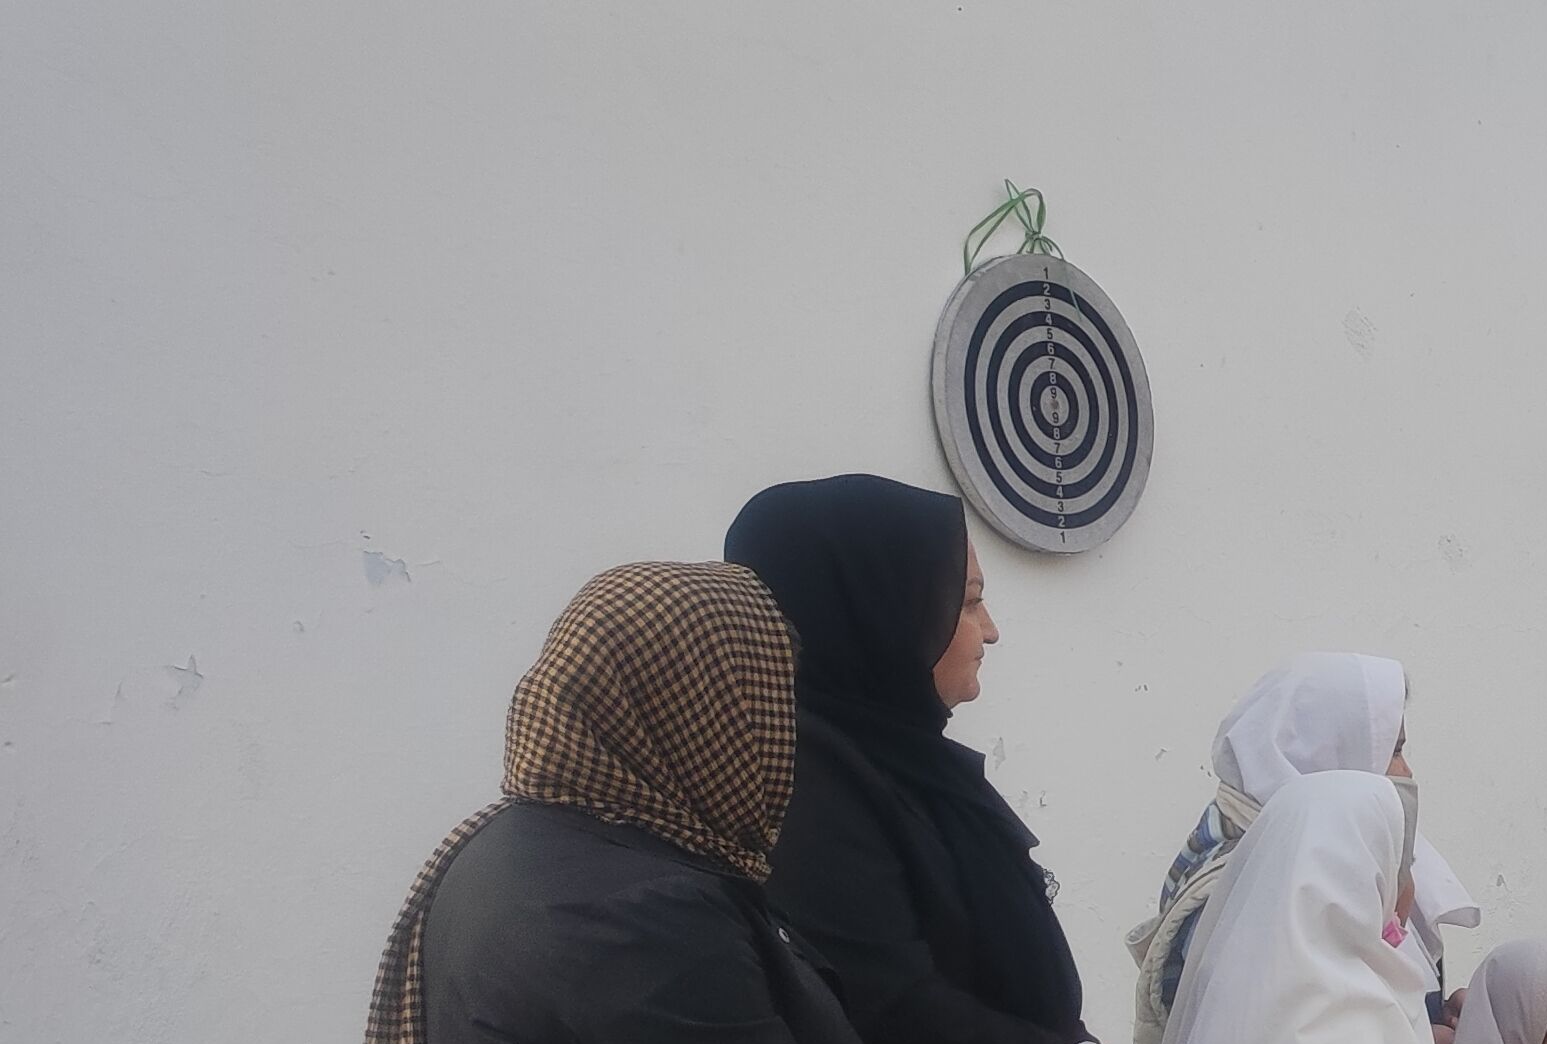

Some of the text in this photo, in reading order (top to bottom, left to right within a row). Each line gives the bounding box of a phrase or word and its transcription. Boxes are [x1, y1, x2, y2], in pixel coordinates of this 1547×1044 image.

[1043, 267, 1048, 279] 1
[1043, 284, 1051, 295] 2
[1045, 299, 1051, 310] 3
[1045, 314, 1052, 325] 4
[1047, 328, 1053, 339] 5
[1047, 343, 1054, 355] 6
[1048, 358, 1055, 369] 7
[1049, 373, 1056, 384] 8
[1050, 388, 1057, 399] 9
[1052, 412, 1059, 424] 9
[1053, 428, 1060, 439] 8
[1054, 442, 1060, 453] 7
[1055, 457, 1062, 468] 6
[1056, 472, 1062, 483] 5
[1056, 486, 1063, 498] 4
[1058, 501, 1064, 512] 3
[1058, 516, 1065, 527] 2
[1060, 531, 1065, 543] 1
